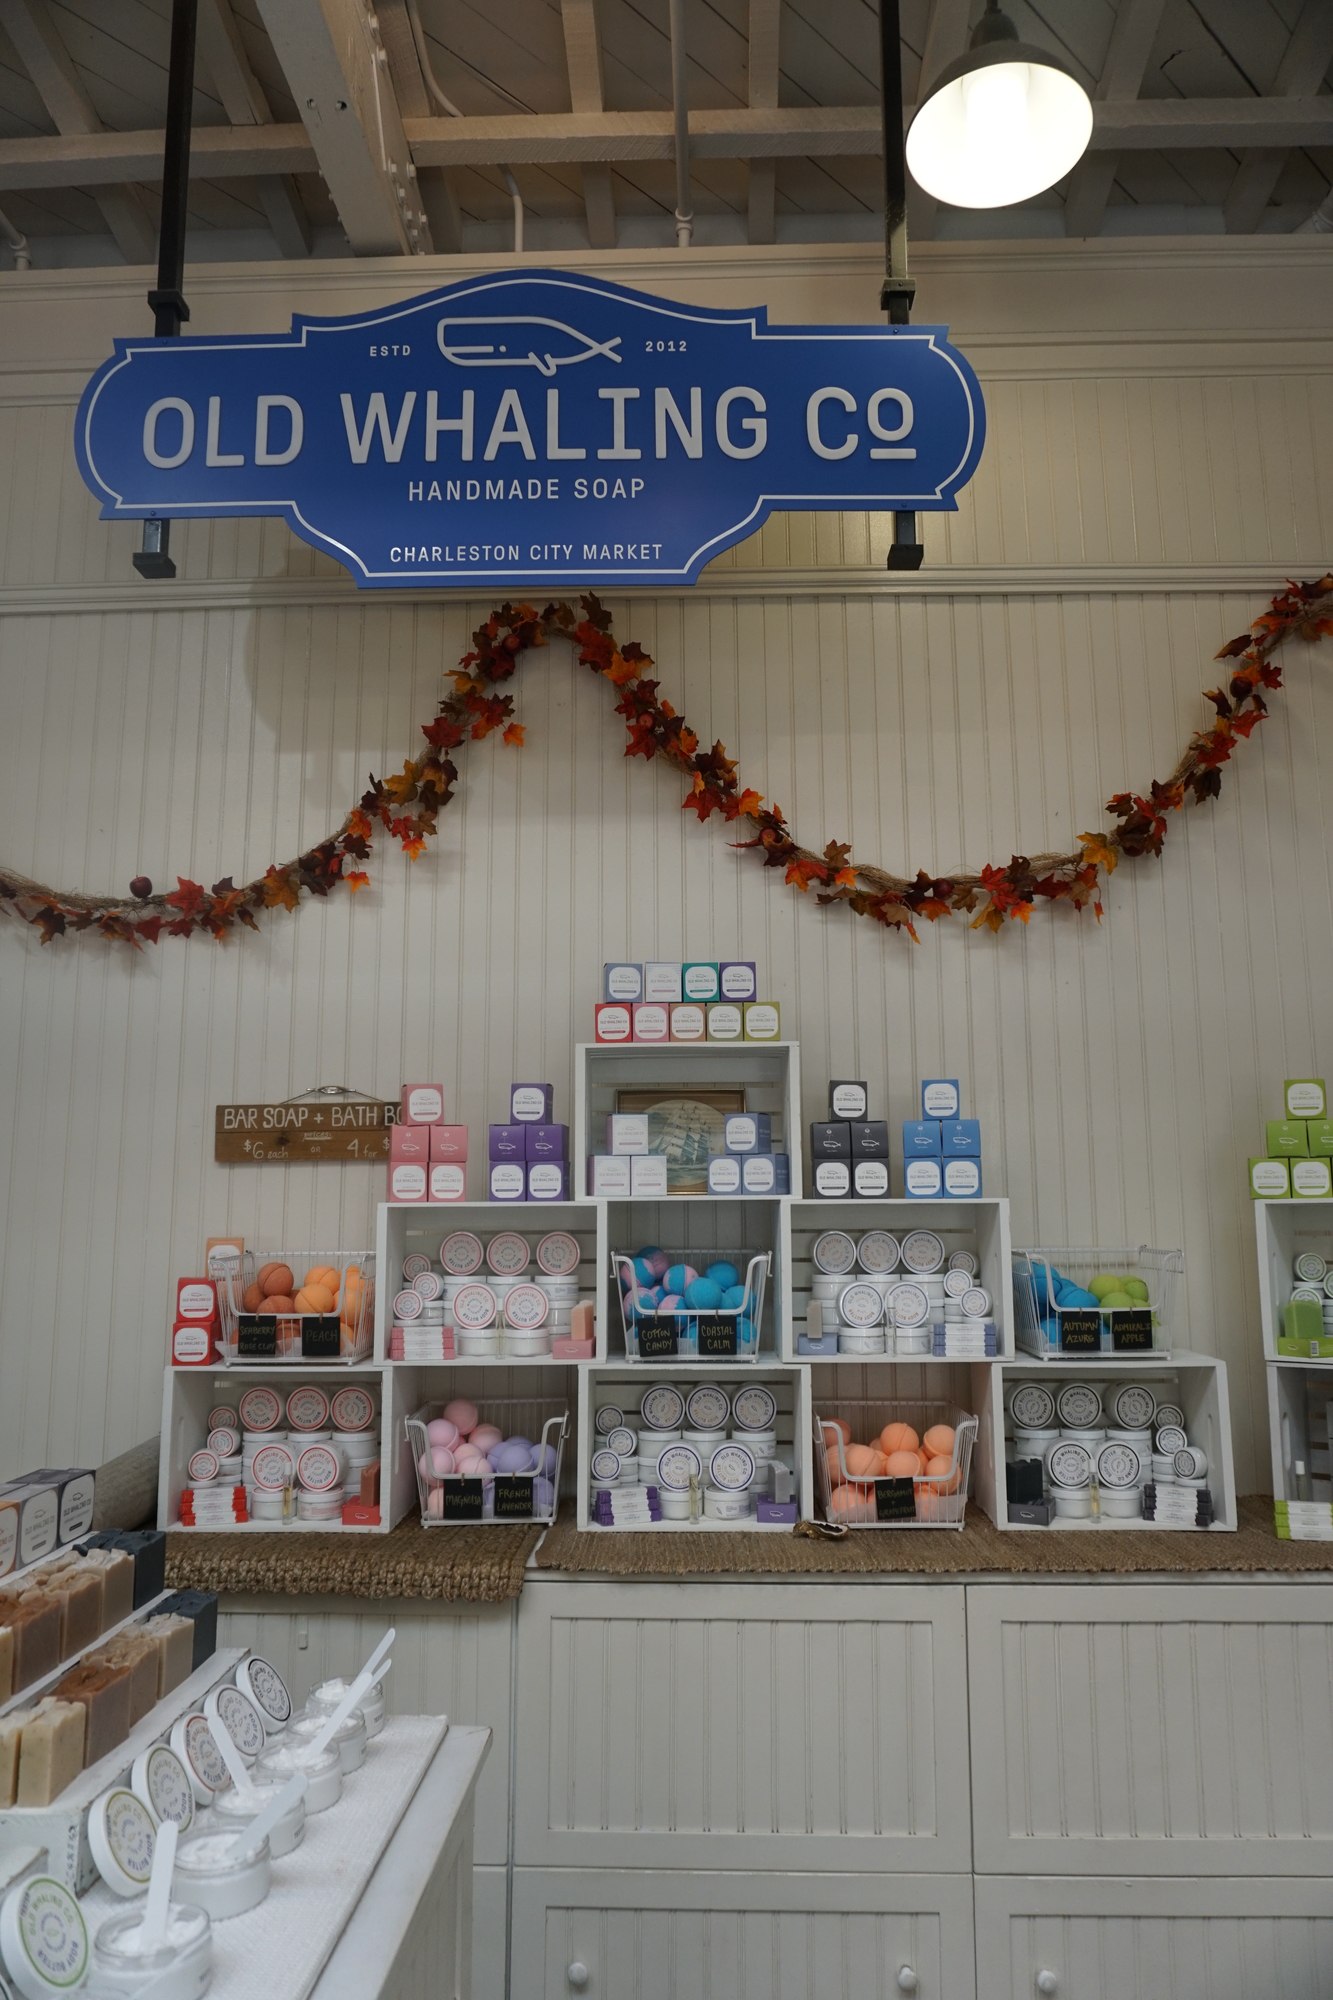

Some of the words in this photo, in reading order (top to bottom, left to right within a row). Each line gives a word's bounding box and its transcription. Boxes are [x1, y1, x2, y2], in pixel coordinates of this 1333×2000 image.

[370, 346, 411, 357] ESTD
[645, 340, 687, 352] 2012
[143, 394, 304, 469] OLD
[340, 386, 768, 464] WHALING
[409, 479, 559, 502] HANDMADE
[573, 478, 645, 499] SOAP
[390, 545, 519, 562] CHARLESTON
[529, 544, 573, 561] CITY
[583, 543, 663, 560] MARKET
[224, 1108, 258, 1129] BAR
[263, 1107, 309, 1128] SOAP
[331, 1106, 377, 1127] BATH
[347, 1138, 358, 1158] 4
[701, 1325, 734, 1337] COASTAL
[1063, 1320, 1098, 1331] AUTUMN
[306, 1329, 338, 1343] PEACH
[642, 1328, 670, 1341] COTTON
[1066, 1334, 1095, 1344] AZURE
[1121, 1334, 1145, 1343] APPLE
[646, 1340, 672, 1351] CANDY
[707, 1339, 730, 1350] CALM
[498, 1488, 530, 1498] FRENCH
[497, 1502, 532, 1512] LAVENDER
